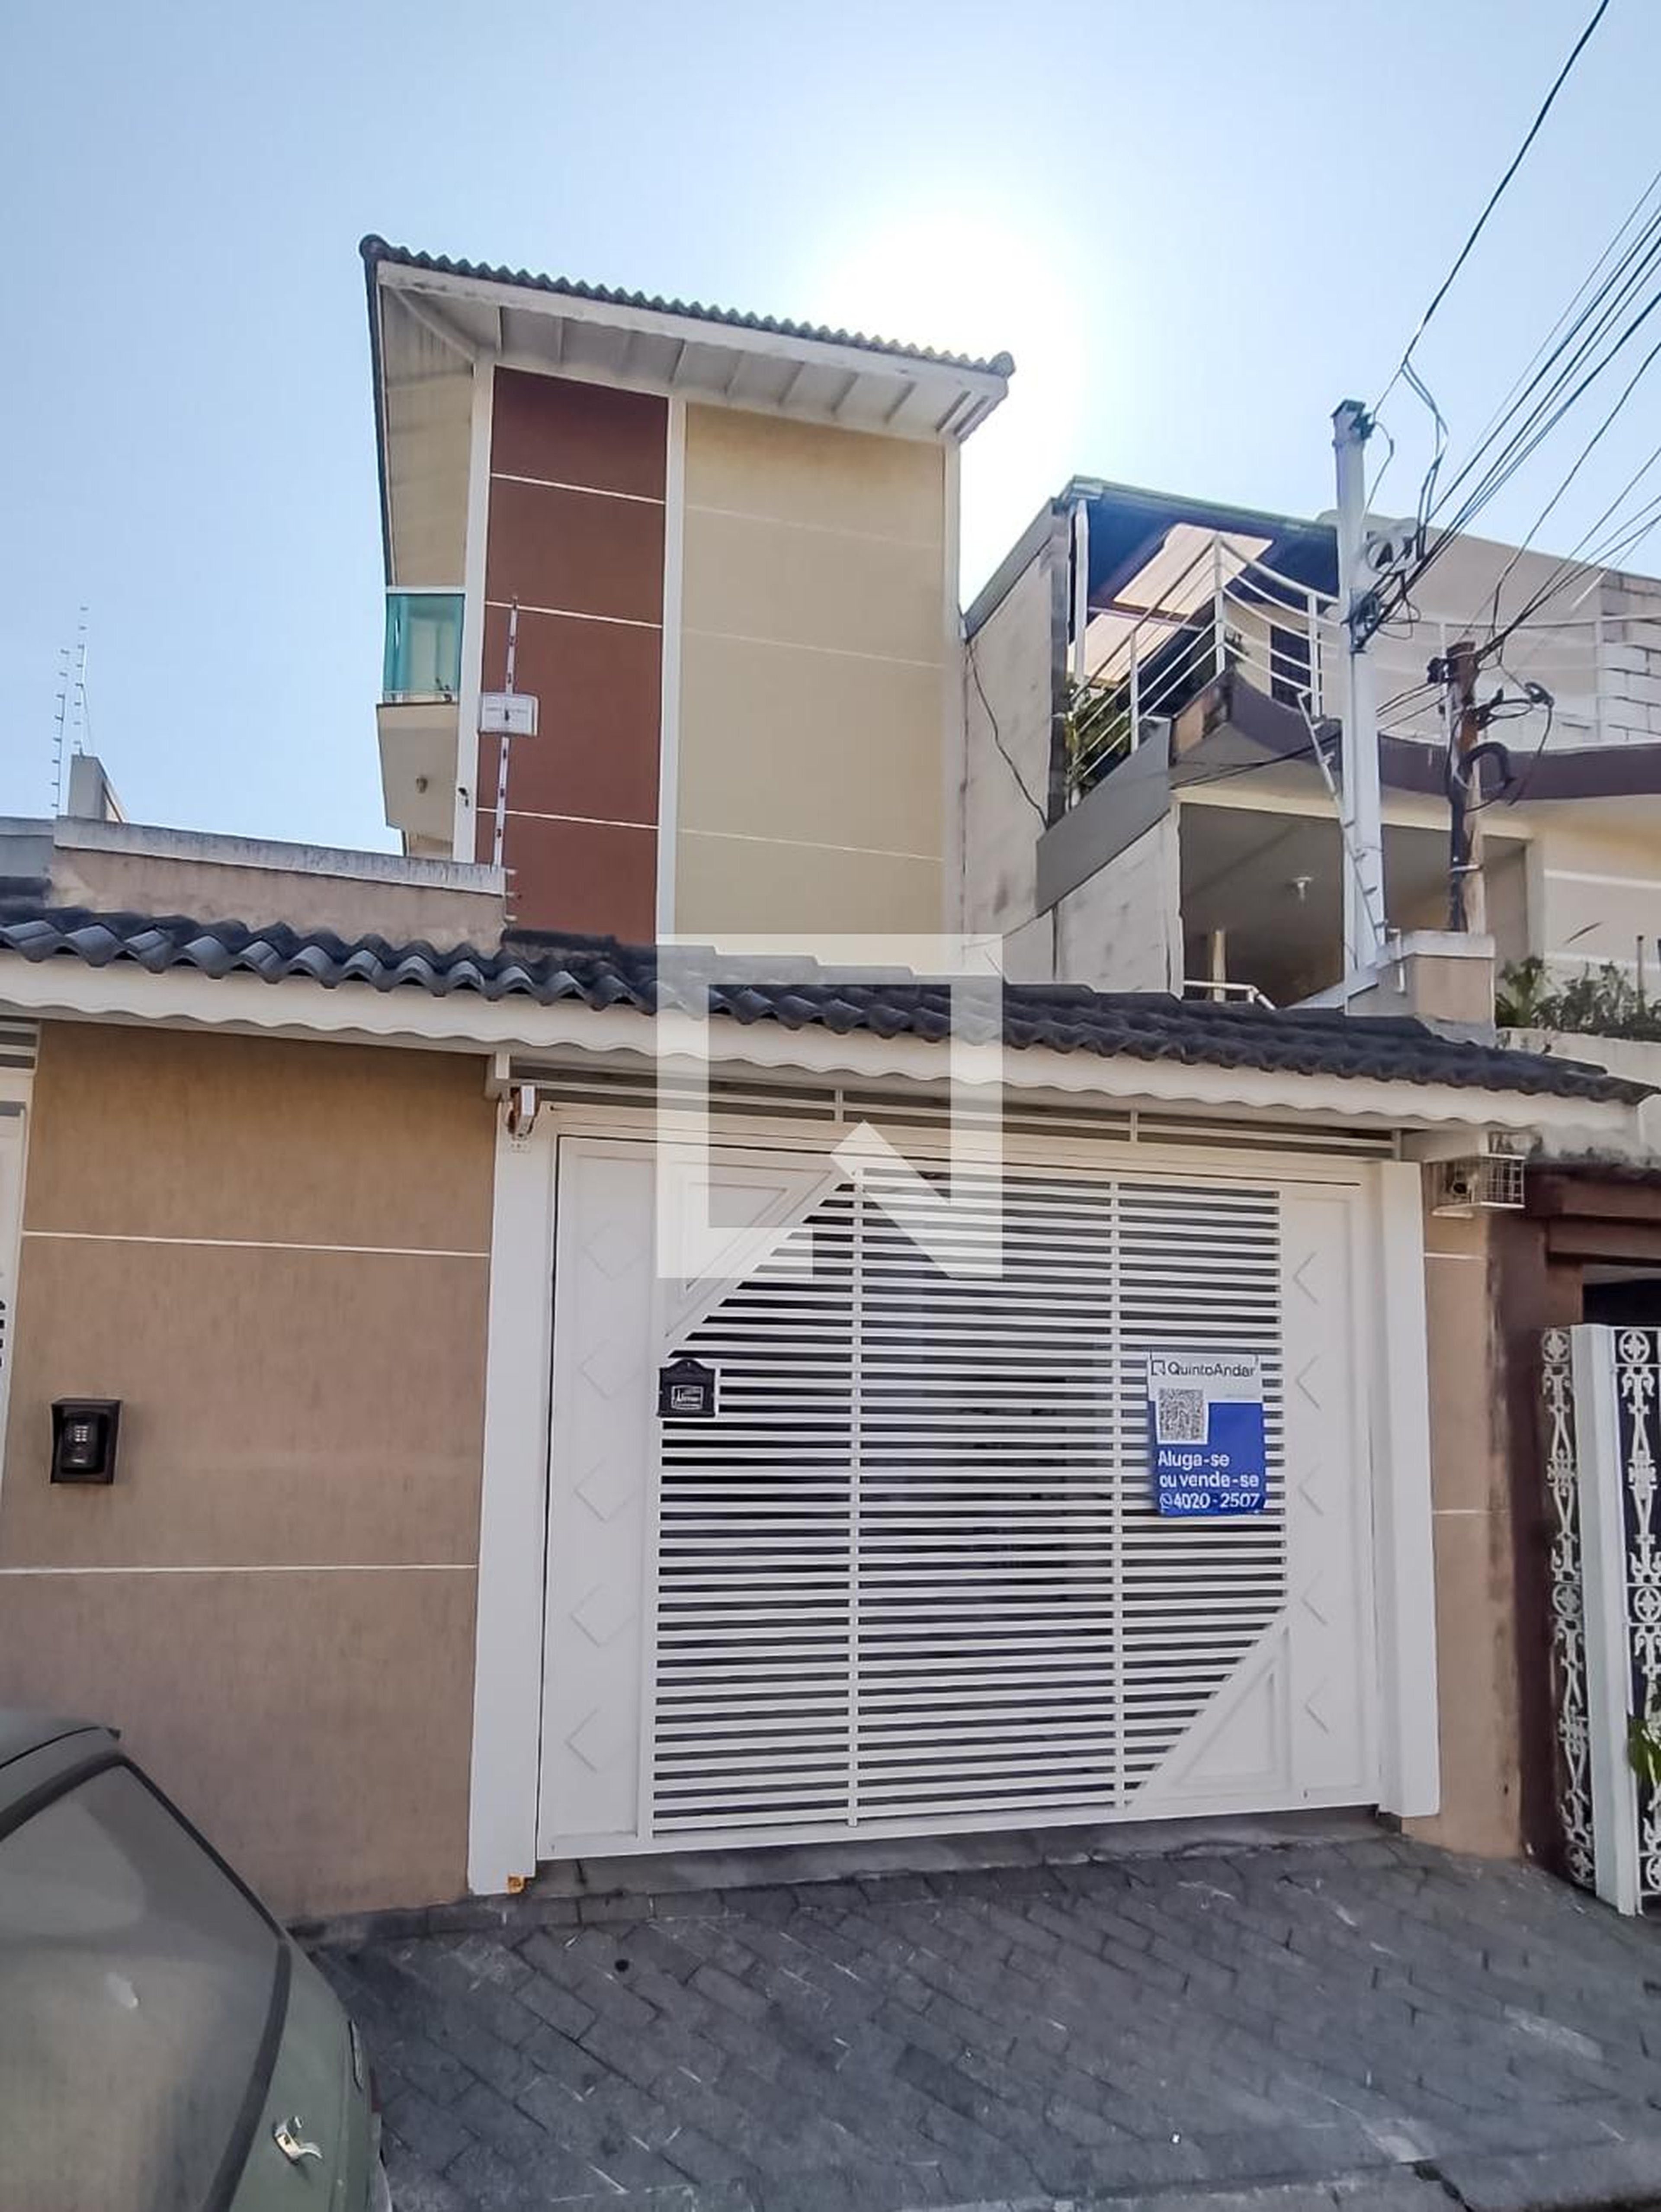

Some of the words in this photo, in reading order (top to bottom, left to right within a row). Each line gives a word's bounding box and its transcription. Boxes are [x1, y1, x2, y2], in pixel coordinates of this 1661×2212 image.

[1168, 1361, 1255, 1377] QuintoAndar
[1158, 1450, 1229, 1470] Aluga-se
[1160, 1475, 1177, 1488] ou
[1179, 1471, 1259, 1488] vende-se
